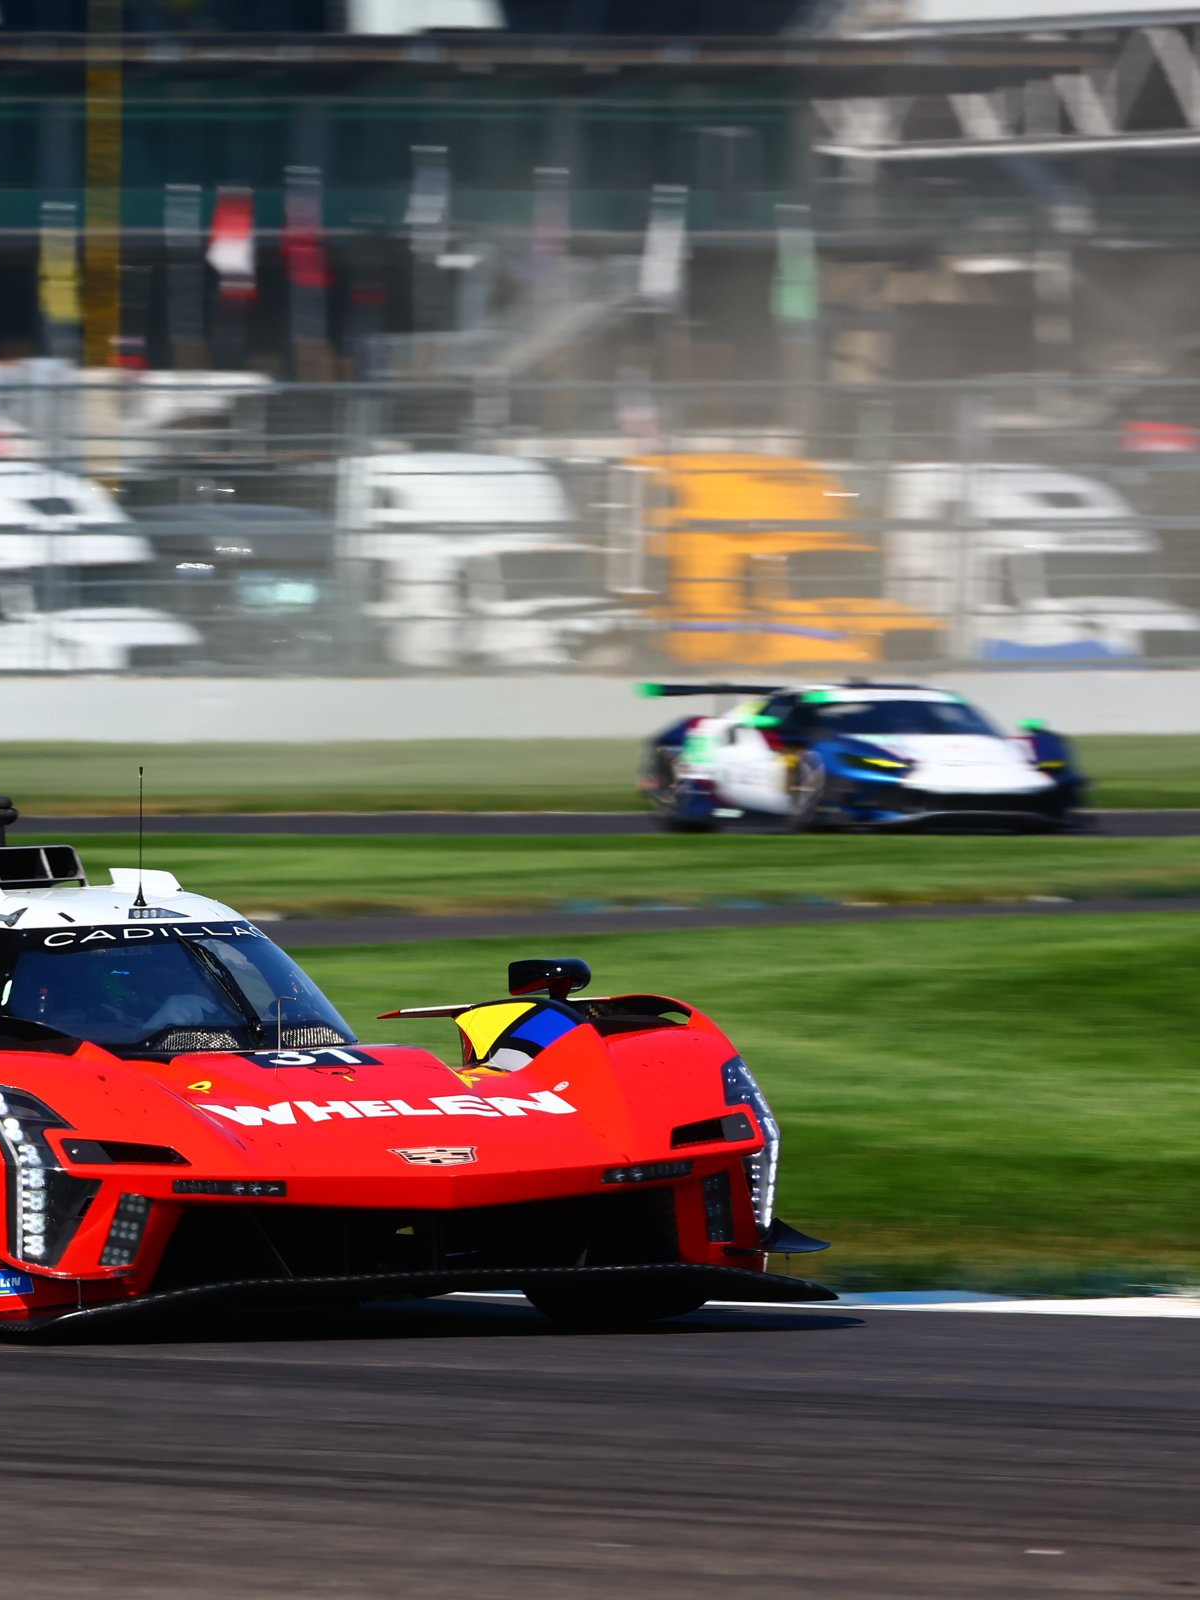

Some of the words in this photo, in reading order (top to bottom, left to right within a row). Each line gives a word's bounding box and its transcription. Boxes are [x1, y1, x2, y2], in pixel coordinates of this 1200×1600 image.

[43, 925, 269, 947] CADILLAC
[255, 1048, 363, 1067] 31
[199, 1089, 578, 1127] WHELEN
